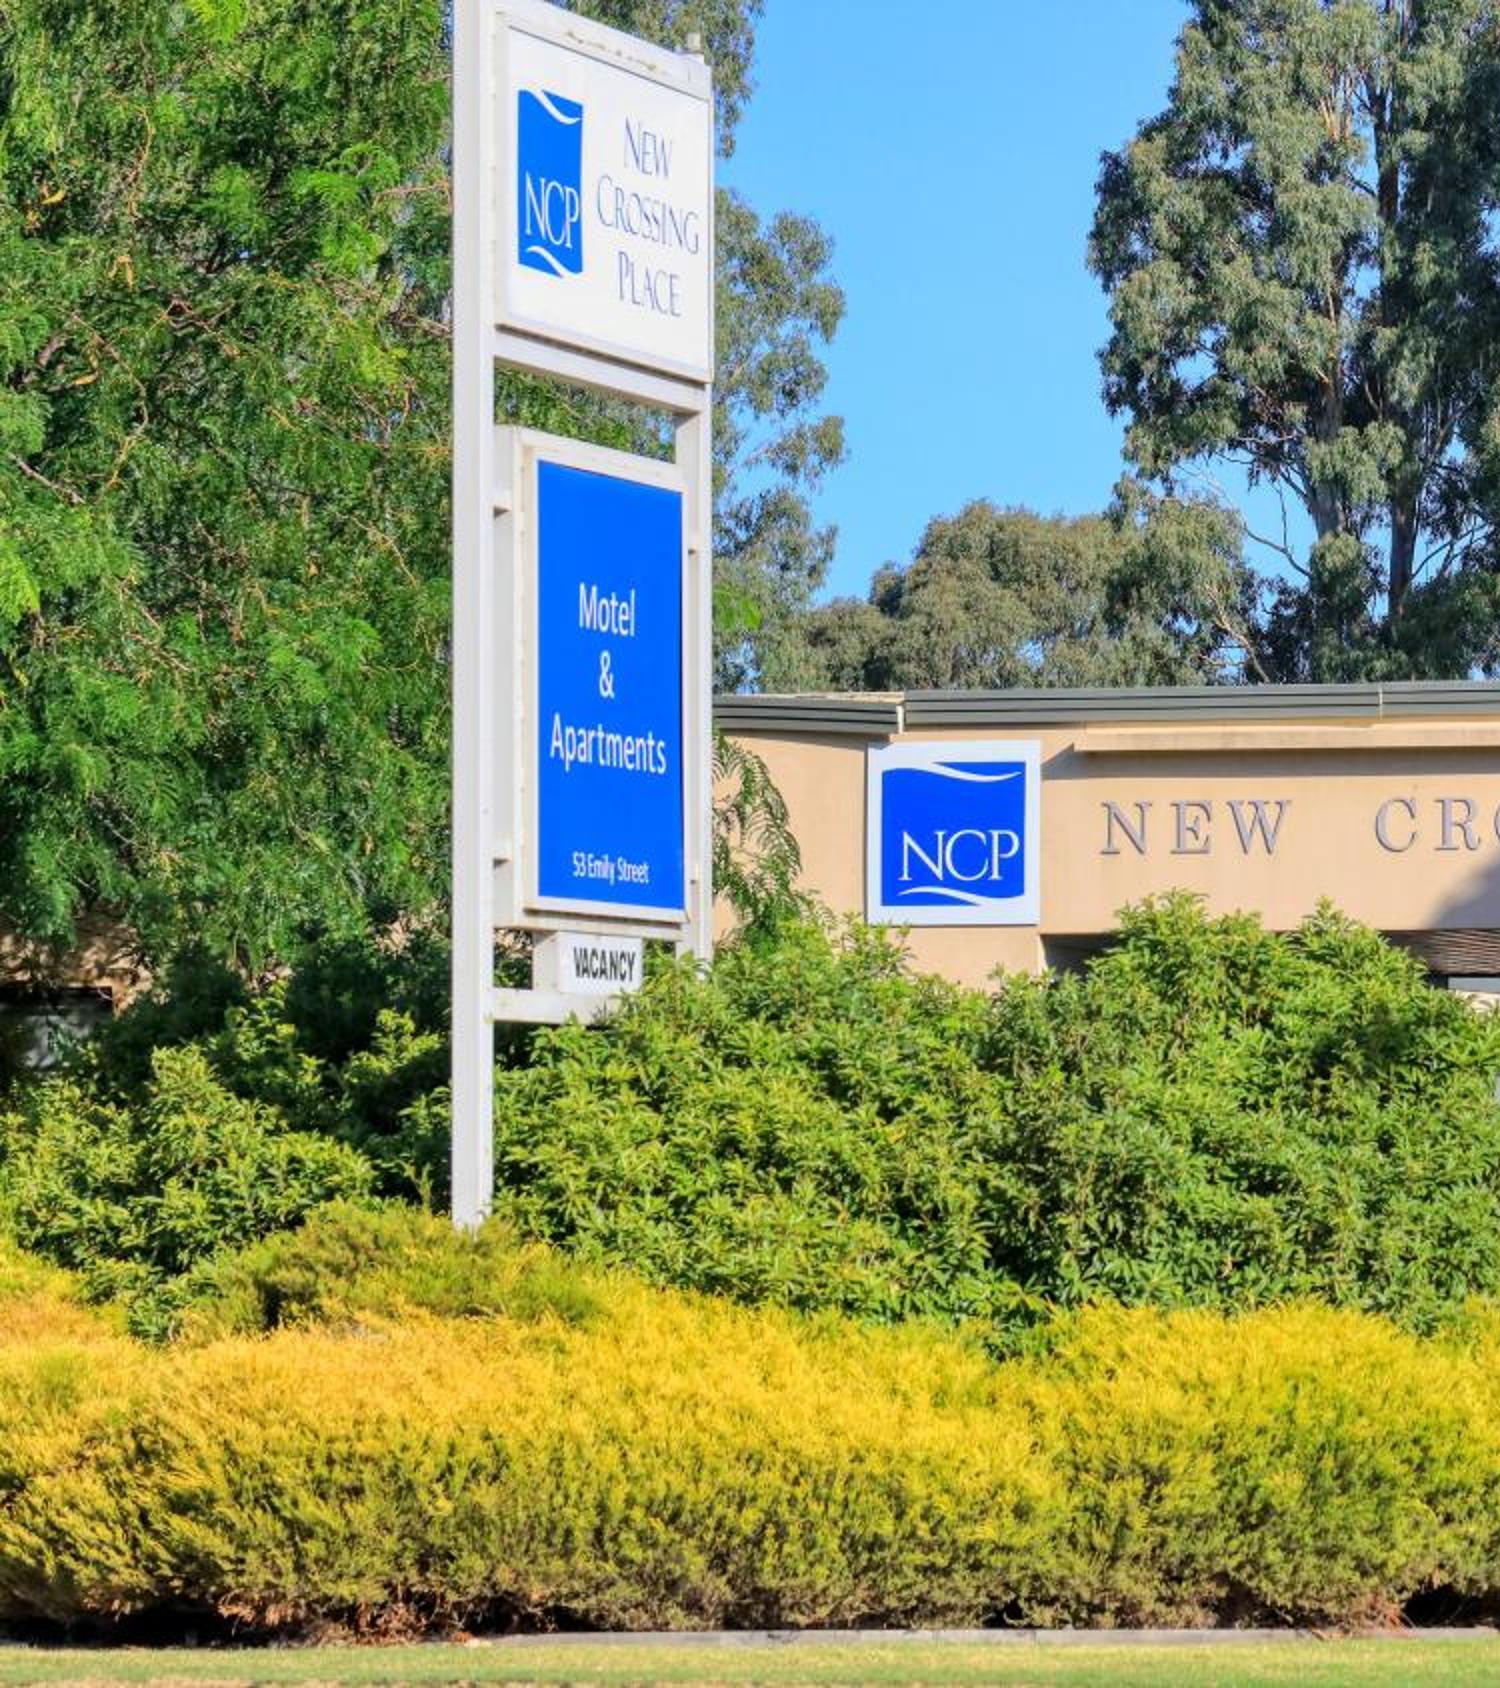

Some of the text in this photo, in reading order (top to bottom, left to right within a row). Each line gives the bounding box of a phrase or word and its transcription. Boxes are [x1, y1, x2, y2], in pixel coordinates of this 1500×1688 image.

[624, 116, 673, 178] NEW
[524, 170, 580, 250] NCP
[597, 174, 699, 255] CROSSING
[617, 250, 682, 318] PLACE
[578, 581, 636, 638] Motel
[599, 649, 616, 700] &
[549, 710, 668, 775] Apartments
[897, 828, 1021, 882] NCP
[1100, 799, 1292, 856] NEW
[572, 850, 650, 887] 53 Emily Street
[572, 946, 637, 983] VACANCY
